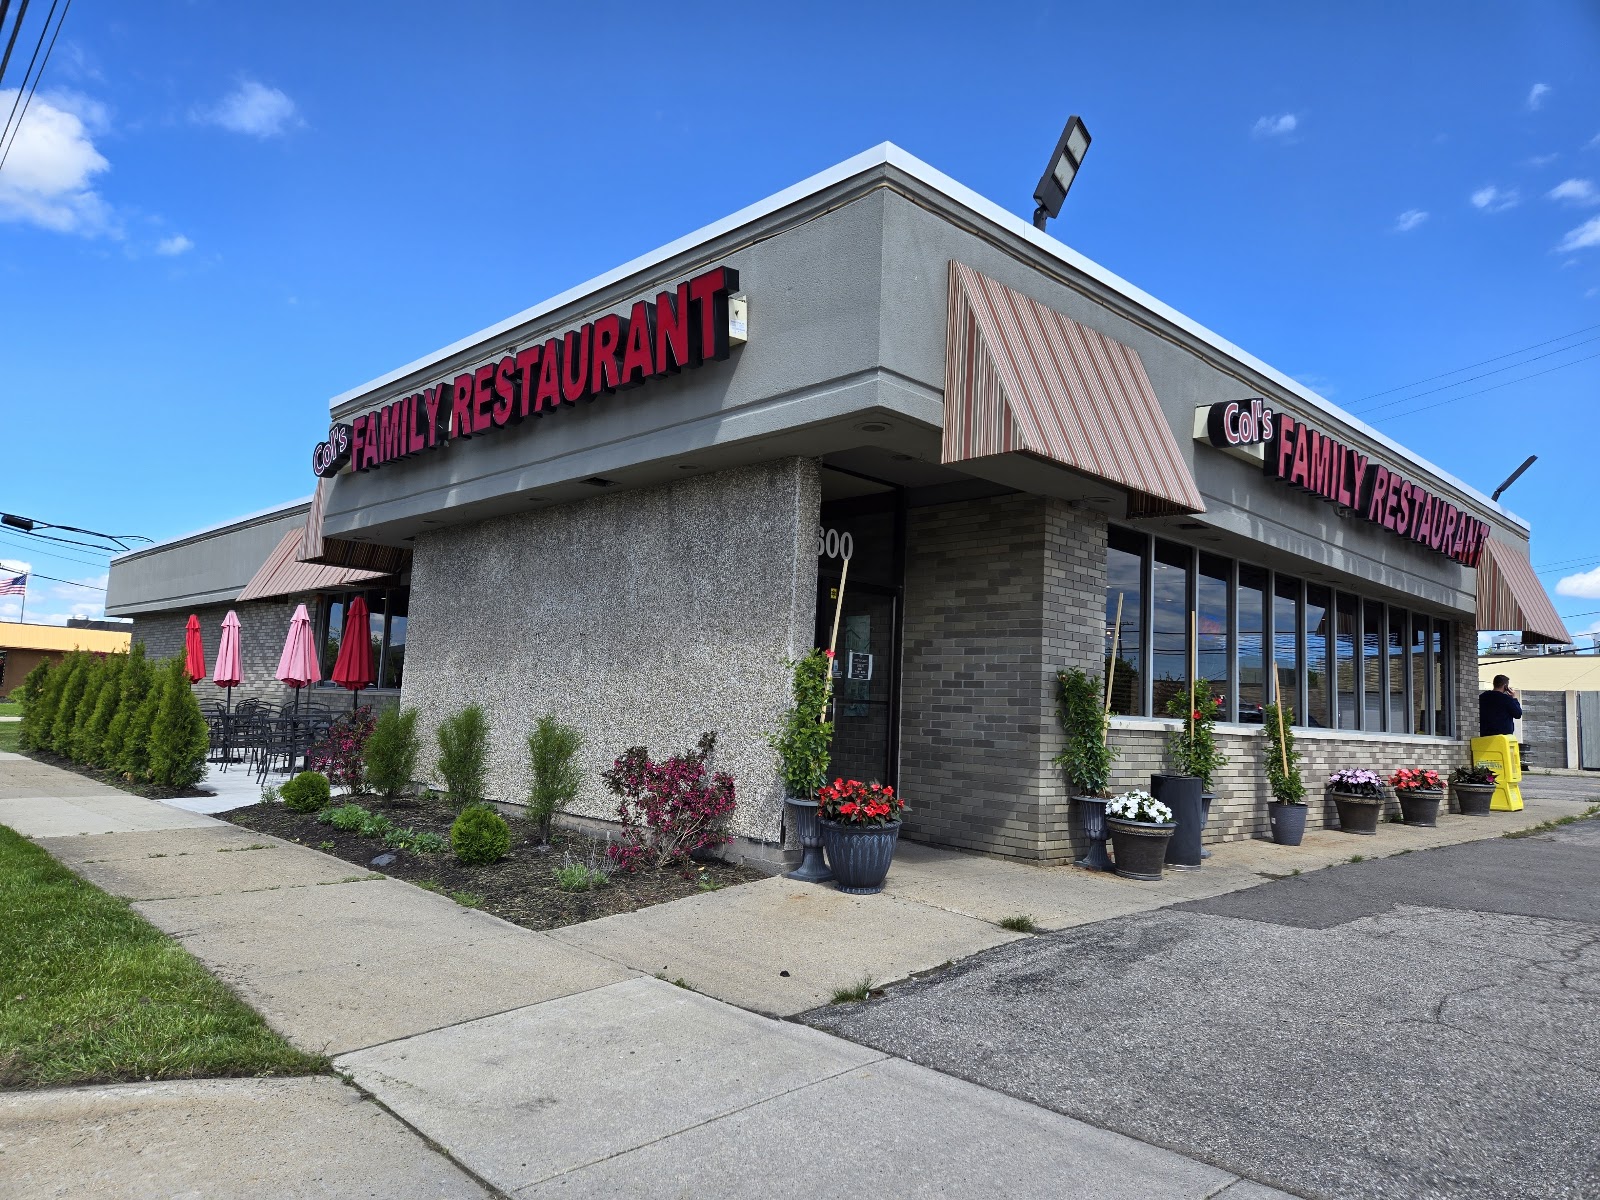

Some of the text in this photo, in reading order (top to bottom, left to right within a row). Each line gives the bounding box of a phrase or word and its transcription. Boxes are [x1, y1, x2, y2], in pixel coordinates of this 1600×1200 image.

[313, 266, 727, 476] Col's FAMILY RESTAURANT
[1223, 399, 1490, 569] Col's FAMILY RESTAURANT
